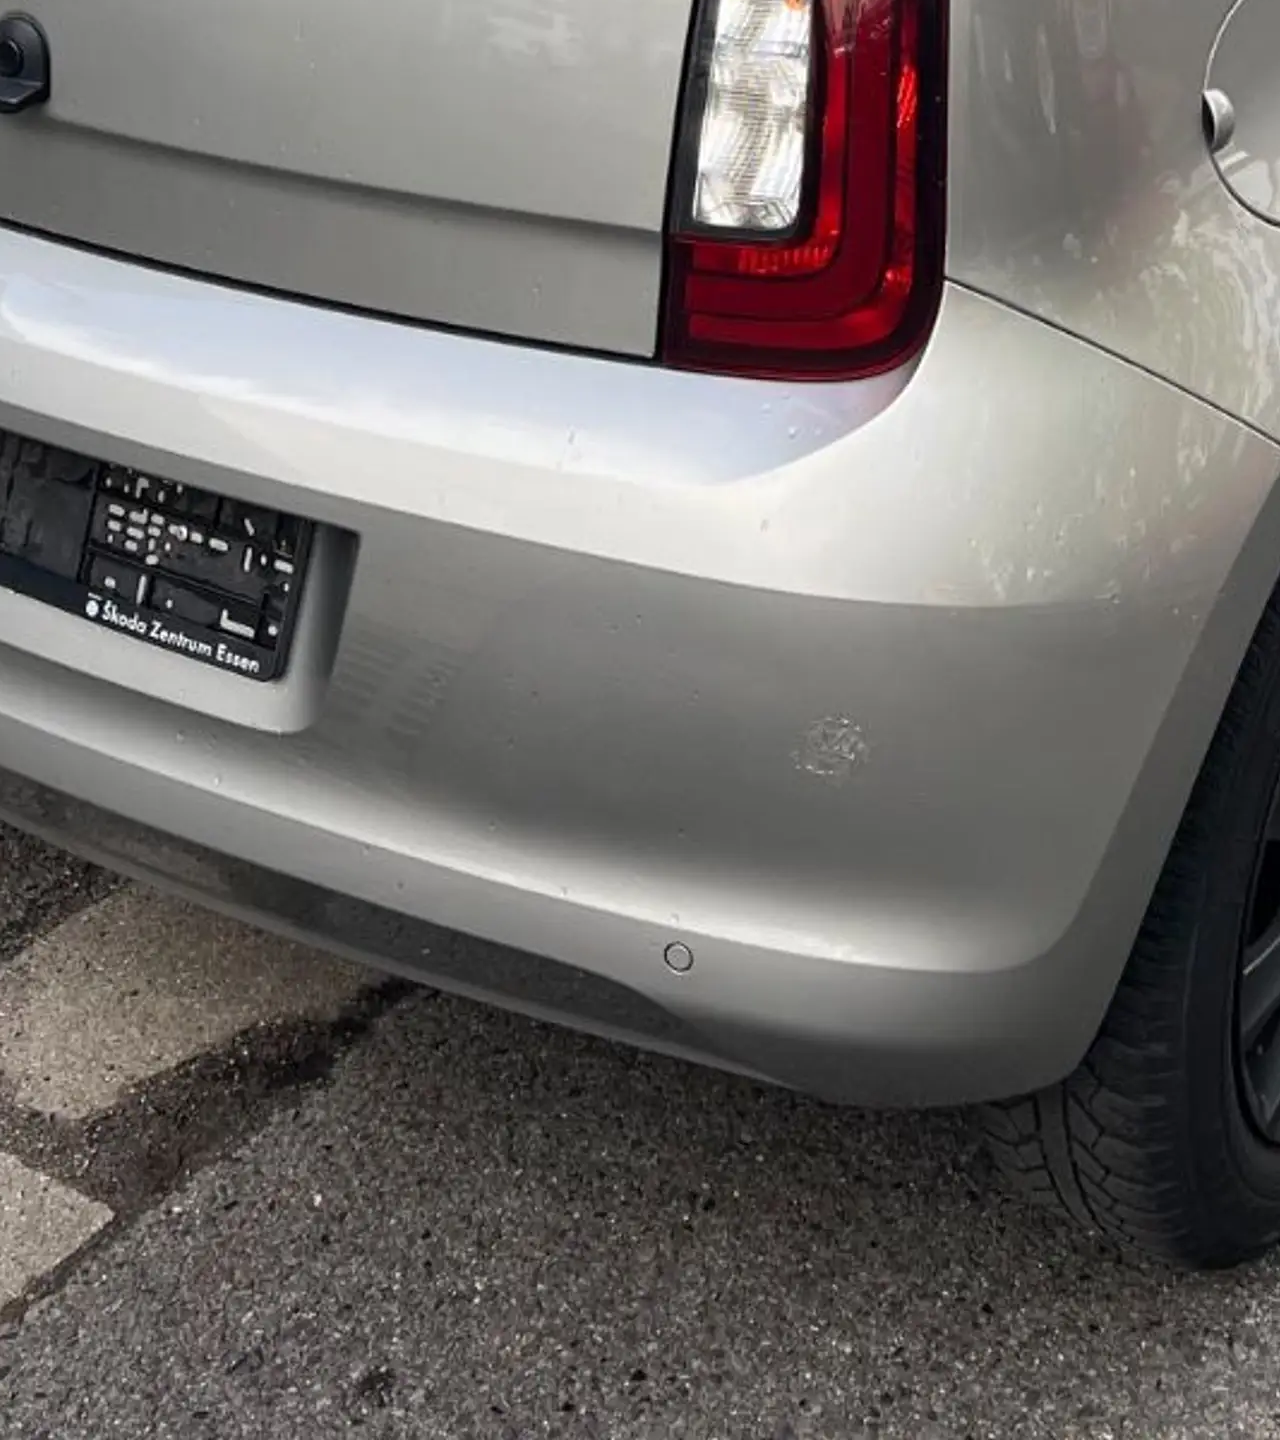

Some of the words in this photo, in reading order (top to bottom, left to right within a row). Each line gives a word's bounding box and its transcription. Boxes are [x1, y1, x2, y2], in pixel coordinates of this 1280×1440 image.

[102, 599, 148, 634] Škoda
[150, 620, 213, 658] Zentrum
[215, 642, 261, 674] Essen
